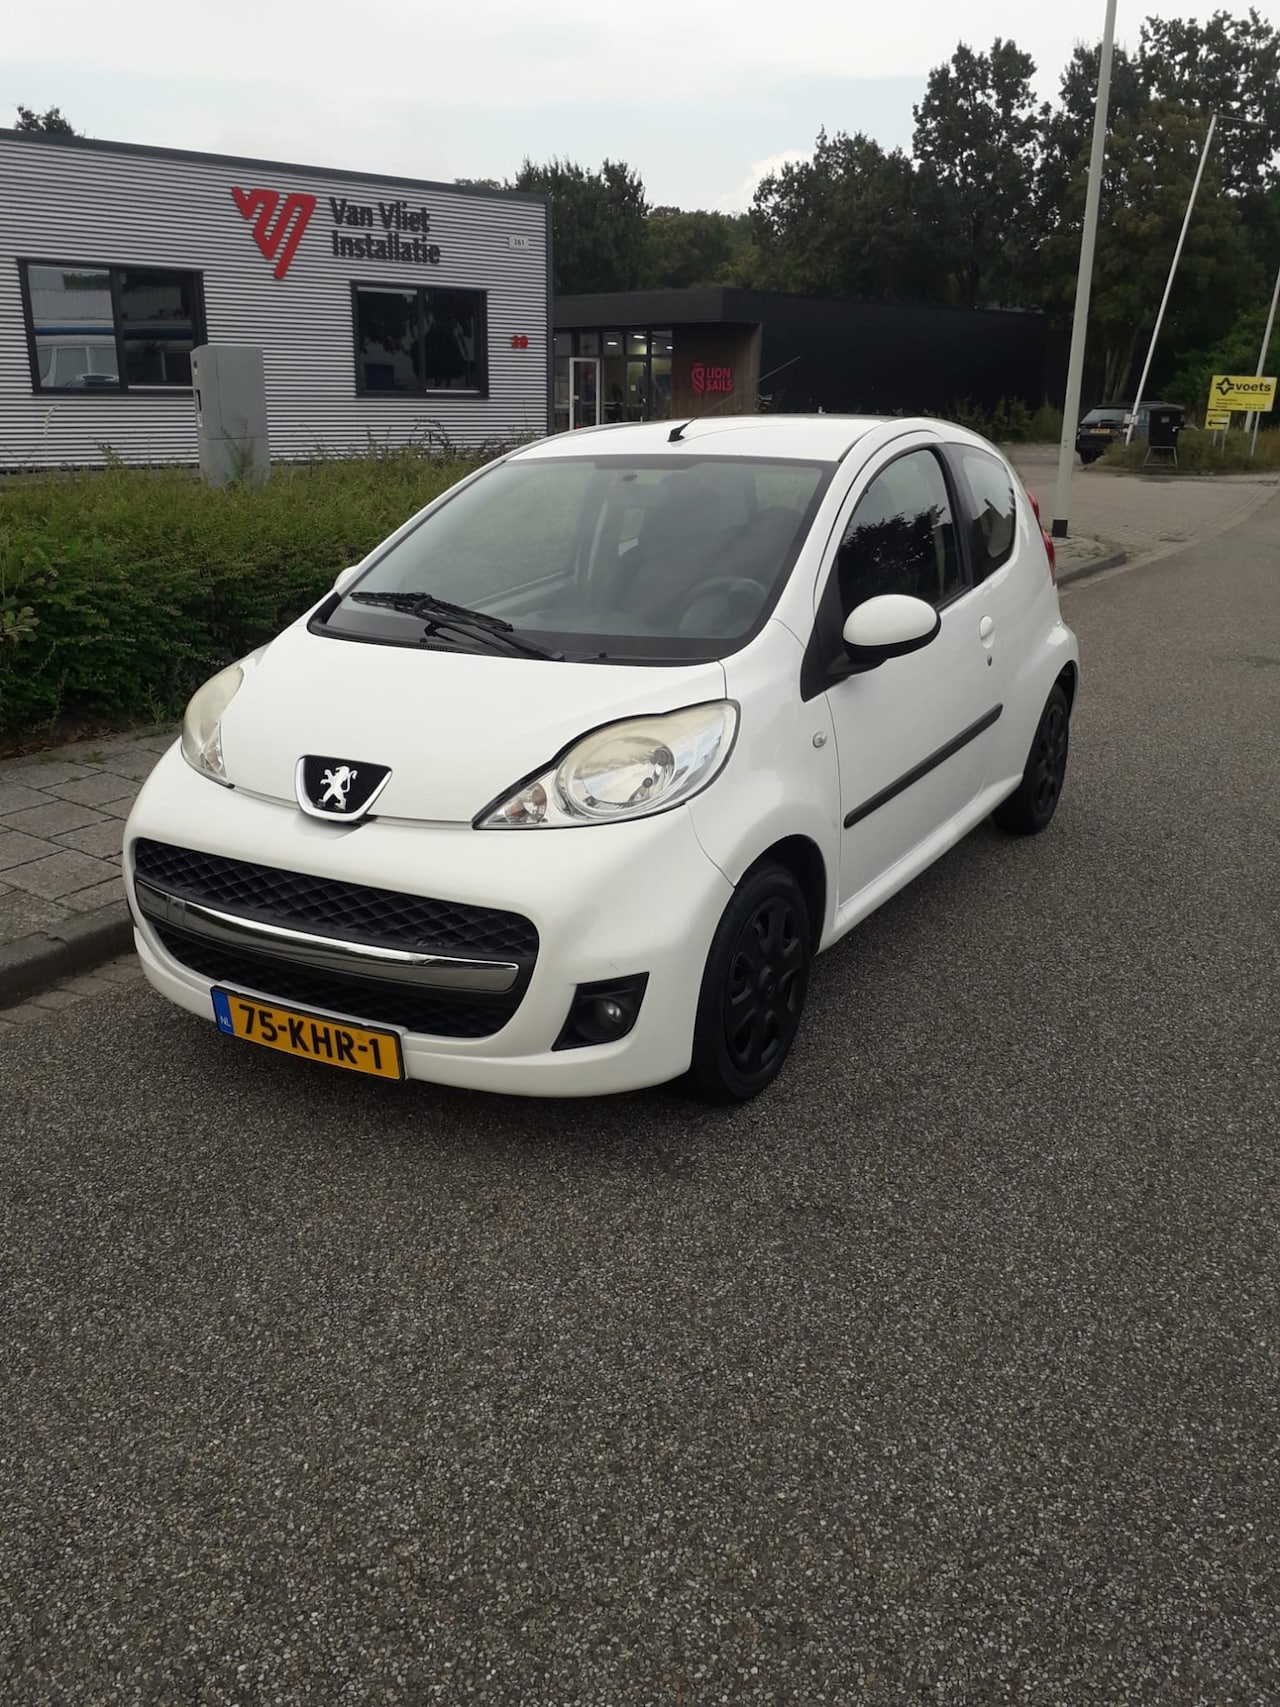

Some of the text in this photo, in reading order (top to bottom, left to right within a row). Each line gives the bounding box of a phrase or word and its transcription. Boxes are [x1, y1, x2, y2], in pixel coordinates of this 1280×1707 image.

[328, 196, 430, 233] Van Vliet
[332, 229, 440, 264] Installatie
[706, 367, 732, 379] LION
[706, 380, 734, 392] SAILS
[1235, 382, 1272, 392] voets
[219, 1015, 232, 1028] NL
[238, 1003, 382, 1070] 75-KHR-1
